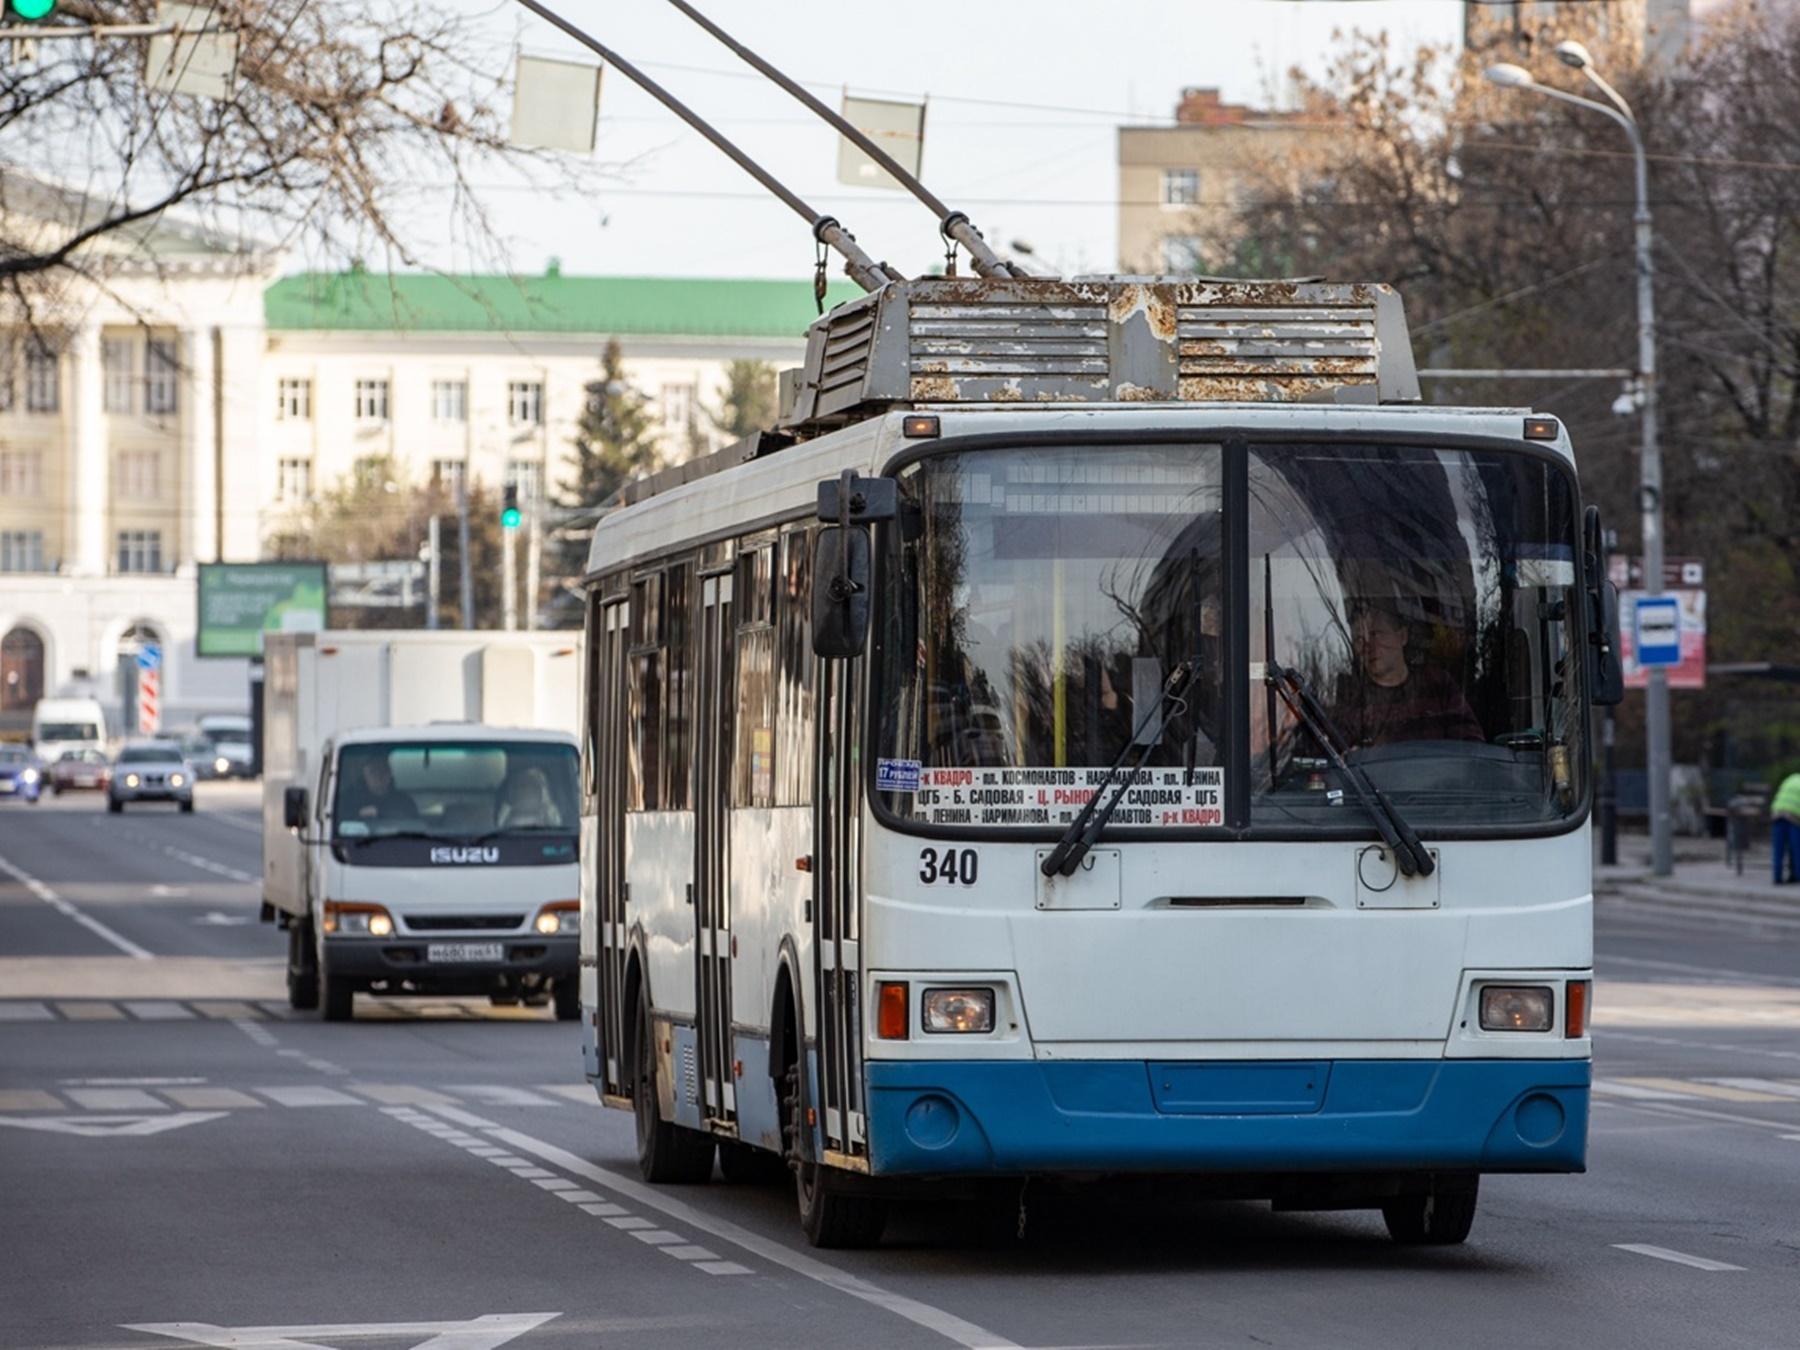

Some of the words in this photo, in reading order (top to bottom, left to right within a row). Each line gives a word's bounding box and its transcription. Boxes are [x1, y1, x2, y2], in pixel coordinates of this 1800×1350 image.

[879, 767, 889, 779] 17
[934, 770, 973, 787] КВАДРО
[983, 773, 998, 785] пл.
[1002, 770, 1076, 785] КОСМОНАВТОВ
[1164, 773, 1179, 785] пл.
[918, 789, 940, 806] ЦГБ
[954, 789, 965, 804] Б.
[970, 789, 1024, 806] САДОВАЯ
[1038, 789, 1049, 806] Ц.
[1128, 789, 1181, 806] САДОВАЯ
[1195, 789, 1217, 806] ЦГБ
[933, 808, 971, 823] ЛЕНИНА
[982, 808, 1049, 823] НАРИМАНОВА
[1078, 808, 1151, 823] СОНАВТОВ
[1163, 811, 1178, 825] р-к
[1182, 808, 1220, 826] КВАДРО
[430, 847, 499, 863] ISUZU
[920, 848, 978, 884] 340
